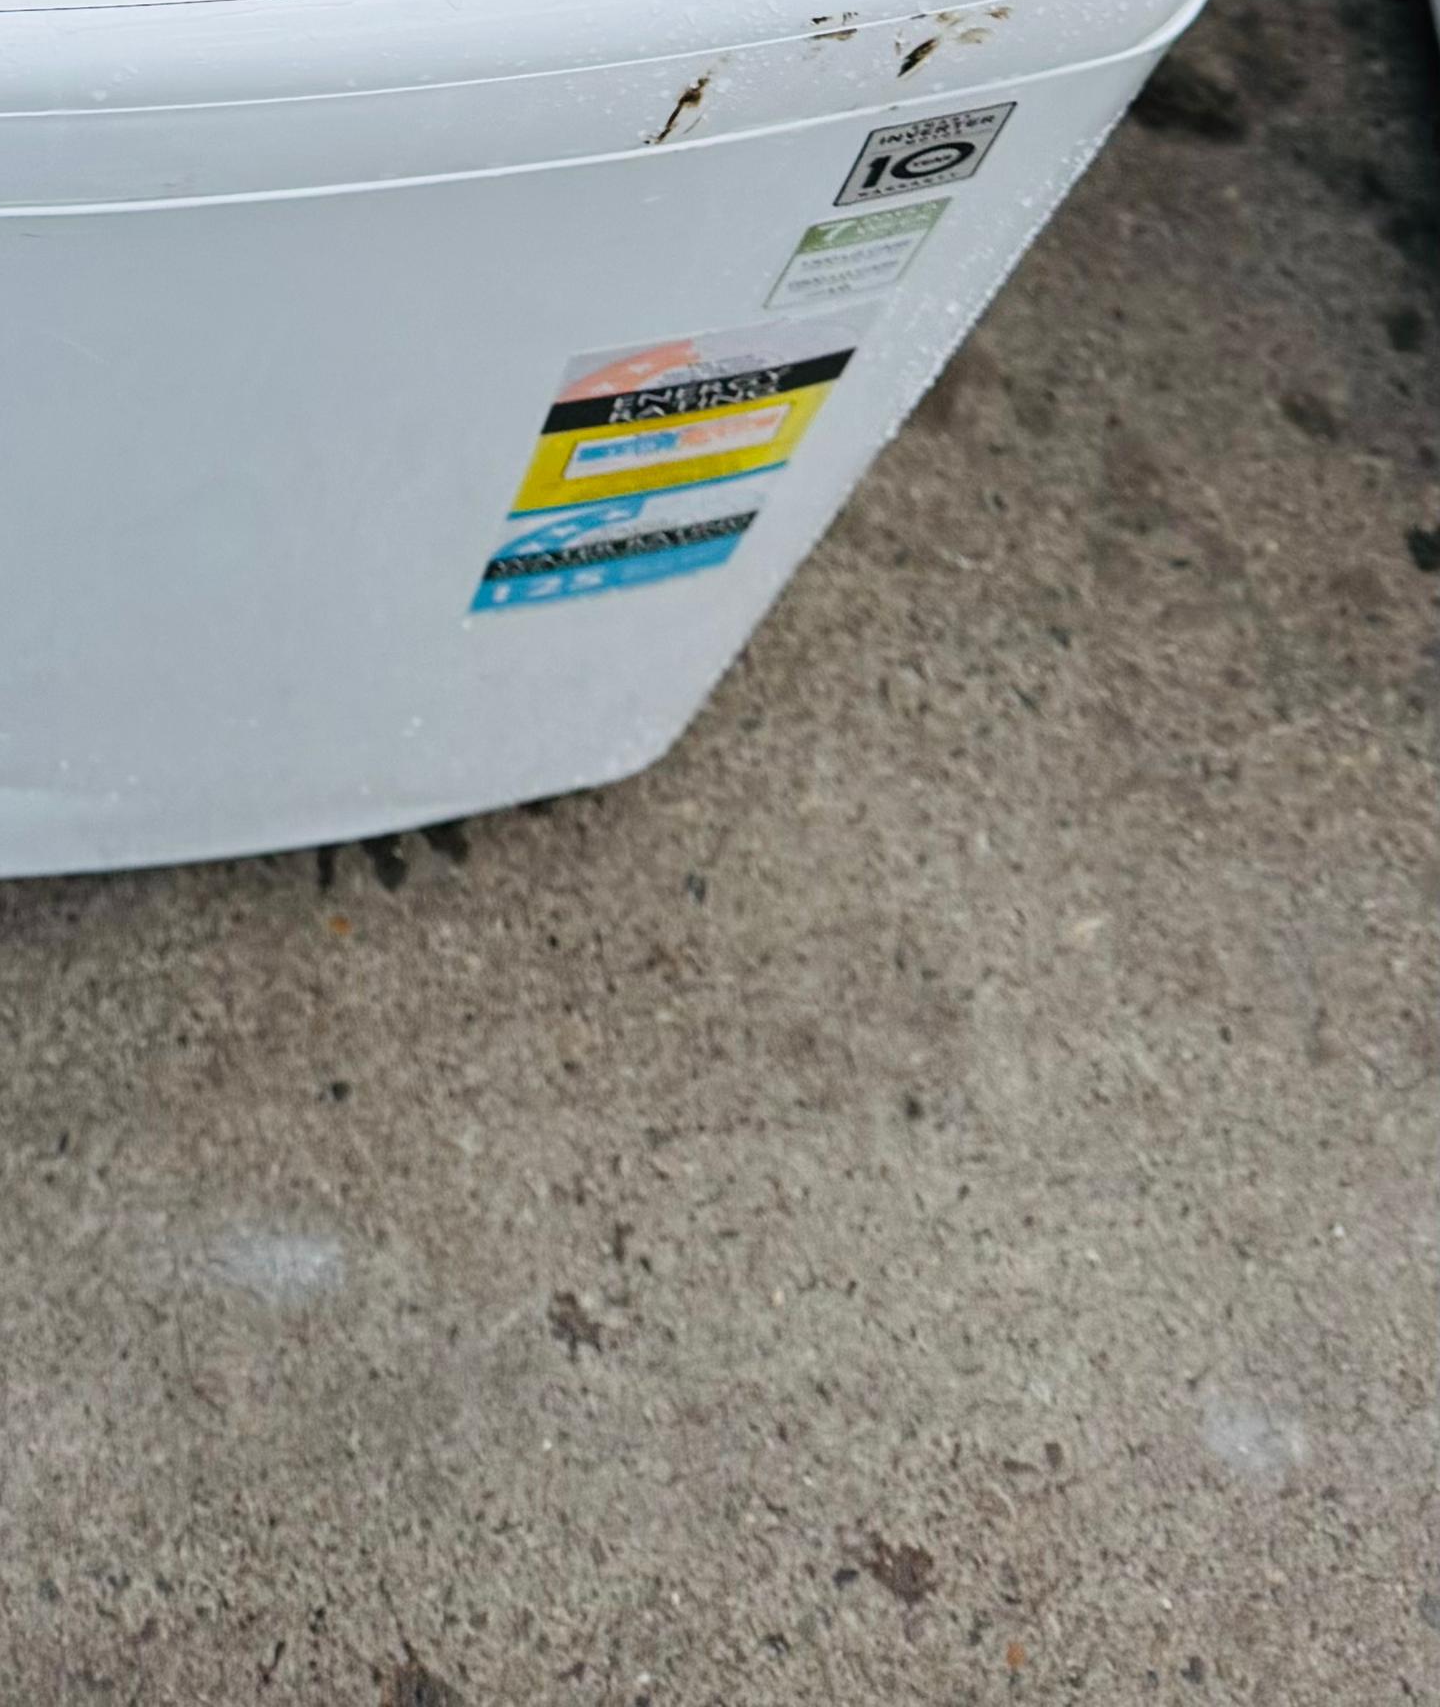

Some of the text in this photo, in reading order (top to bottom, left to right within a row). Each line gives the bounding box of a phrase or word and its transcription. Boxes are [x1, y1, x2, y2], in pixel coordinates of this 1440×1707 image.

[879, 114, 995, 145] INVERTER
[862, 142, 976, 188] 10
[610, 365, 791, 411] ENERGY
